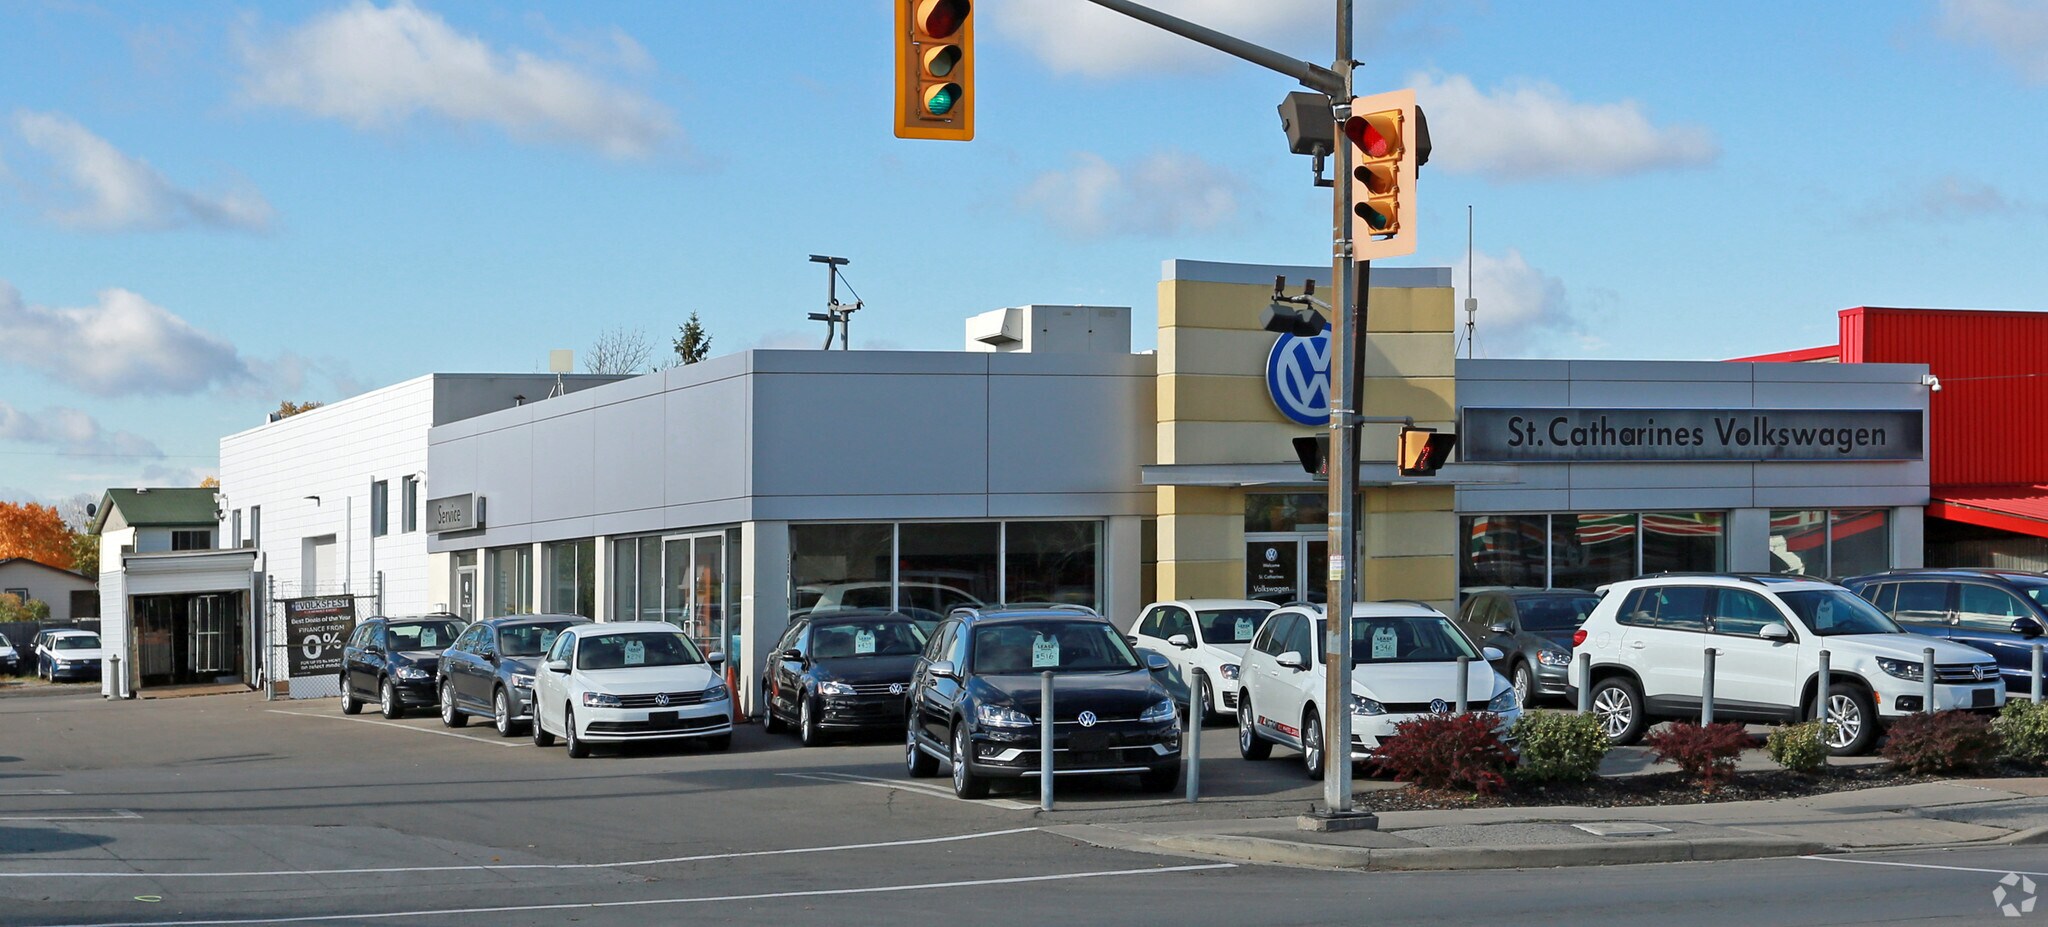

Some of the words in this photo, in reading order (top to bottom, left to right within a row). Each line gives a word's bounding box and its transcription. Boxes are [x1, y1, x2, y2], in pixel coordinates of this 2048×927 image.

[1507, 416, 1544, 447] St.
[1548, 416, 1704, 447] Catharines
[1714, 416, 1886, 454] Volkswagen
[438, 504, 461, 524] Service
[1253, 585, 1290, 593] Volkswagen
[300, 599, 349, 610] VOLKSFEST
[302, 632, 342, 659] 0%
